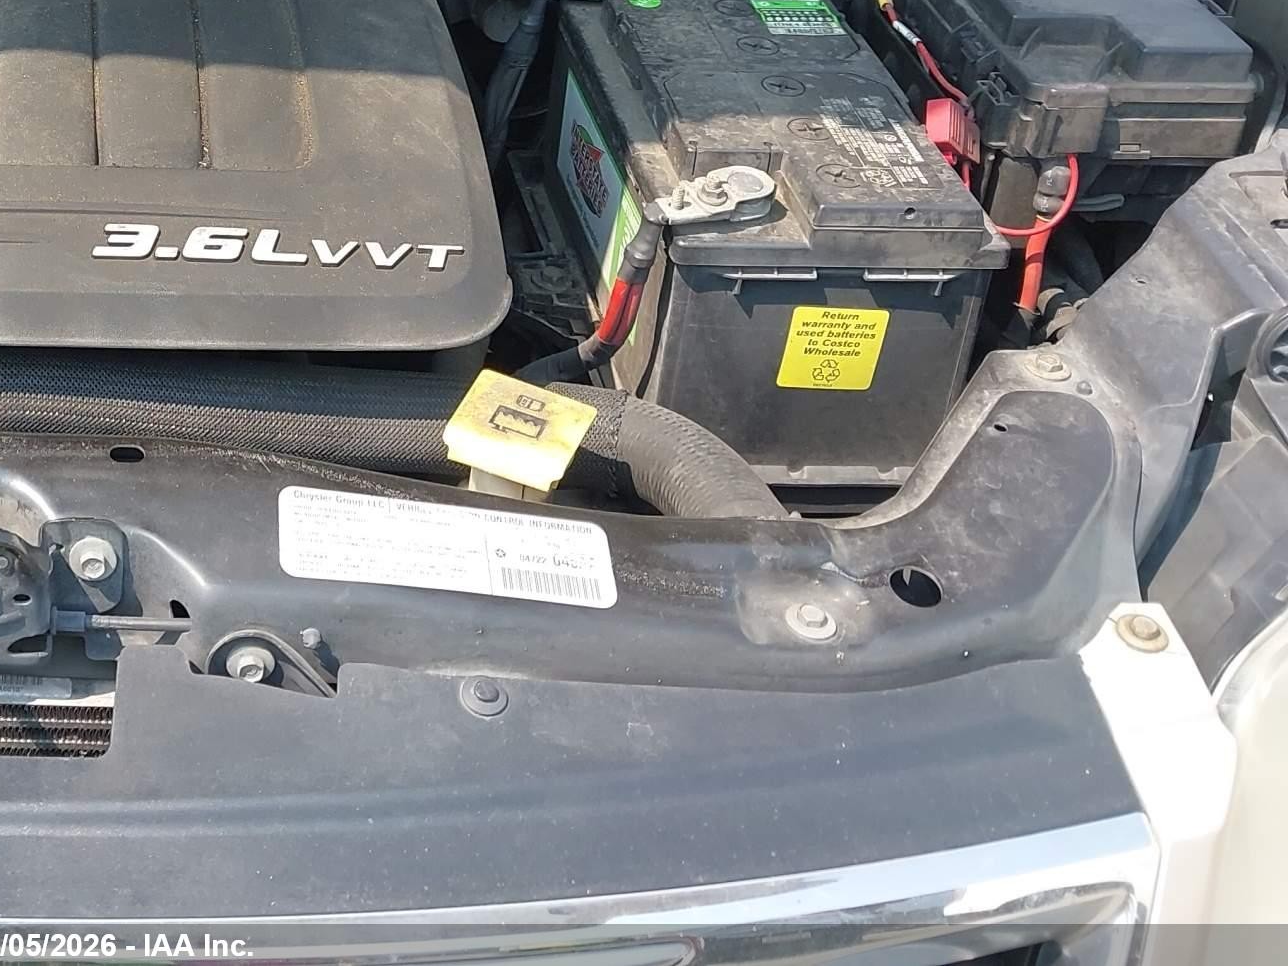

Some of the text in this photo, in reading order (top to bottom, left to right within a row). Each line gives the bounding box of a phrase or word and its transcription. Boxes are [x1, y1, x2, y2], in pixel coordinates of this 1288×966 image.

[91, 223, 465, 271] 3.6L VVT
[821, 311, 860, 320] Return
[802, 321, 877, 331] warranty and
[796, 330, 876, 339] used batteries
[822, 339, 860, 347] Costco
[803, 347, 861, 357] Wholesale
